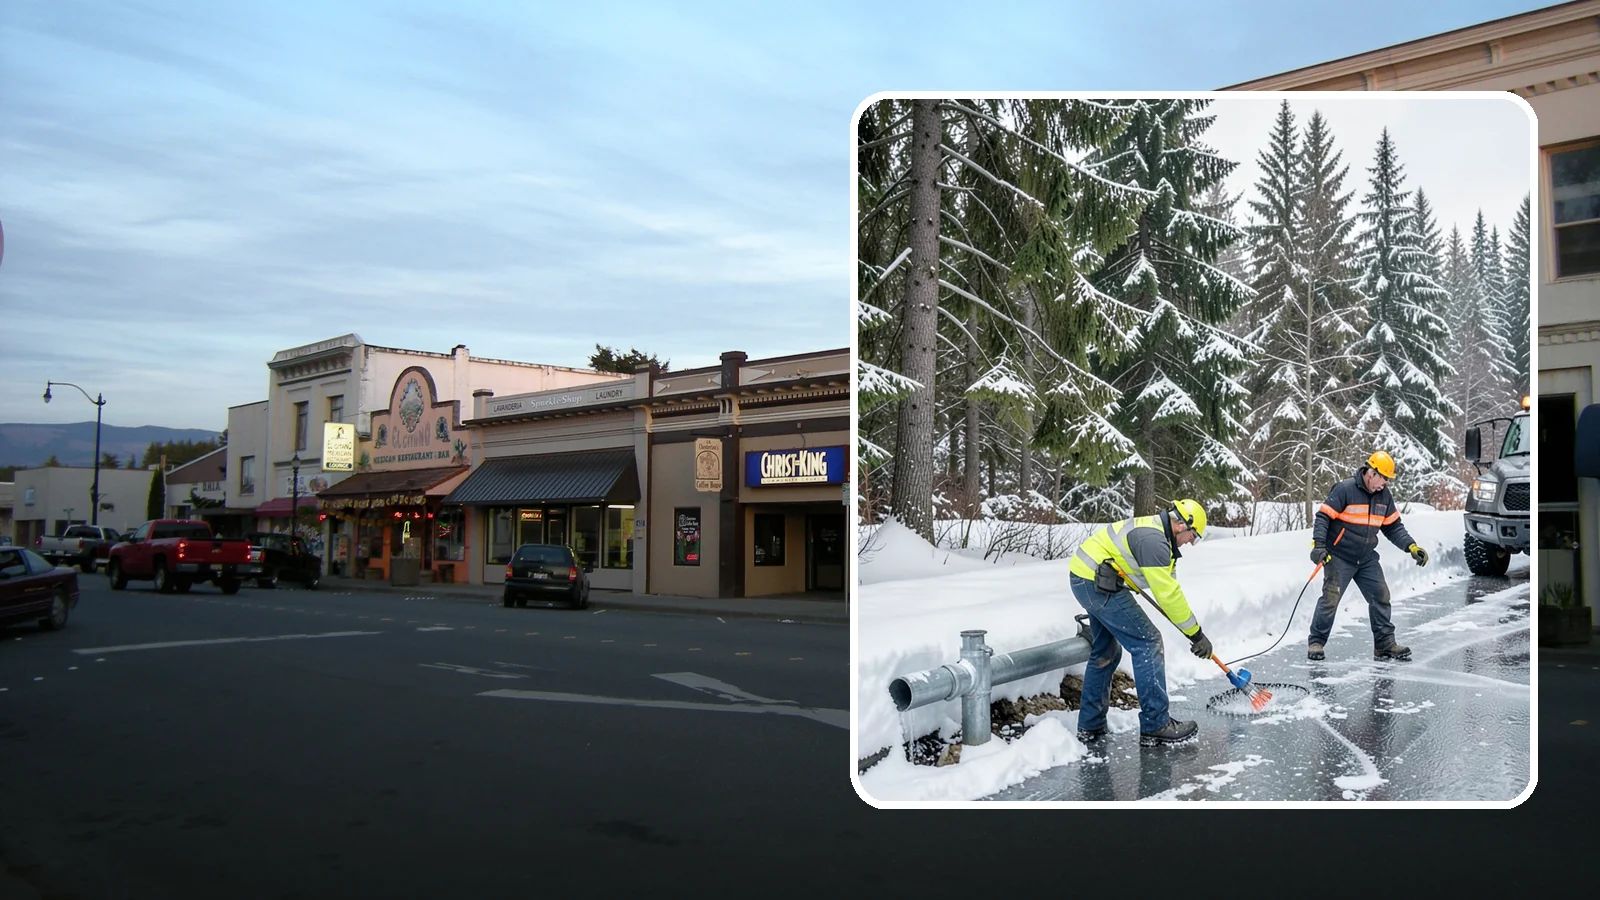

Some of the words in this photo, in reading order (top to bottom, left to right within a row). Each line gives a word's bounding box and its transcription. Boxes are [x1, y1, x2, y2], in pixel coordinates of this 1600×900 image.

[494, 402, 522, 412] LAVANDERIA
[531, 399, 560, 409] Sparkle
[562, 394, 582, 405] Shop
[595, 389, 623, 399] LAUNDRY
[373, 455, 396, 464] MEXICAN
[397, 451, 433, 462] RESTAURANT
[437, 450, 450, 459] BAR
[760, 452, 797, 478] CHRIST
[799, 450, 827, 476] KING
